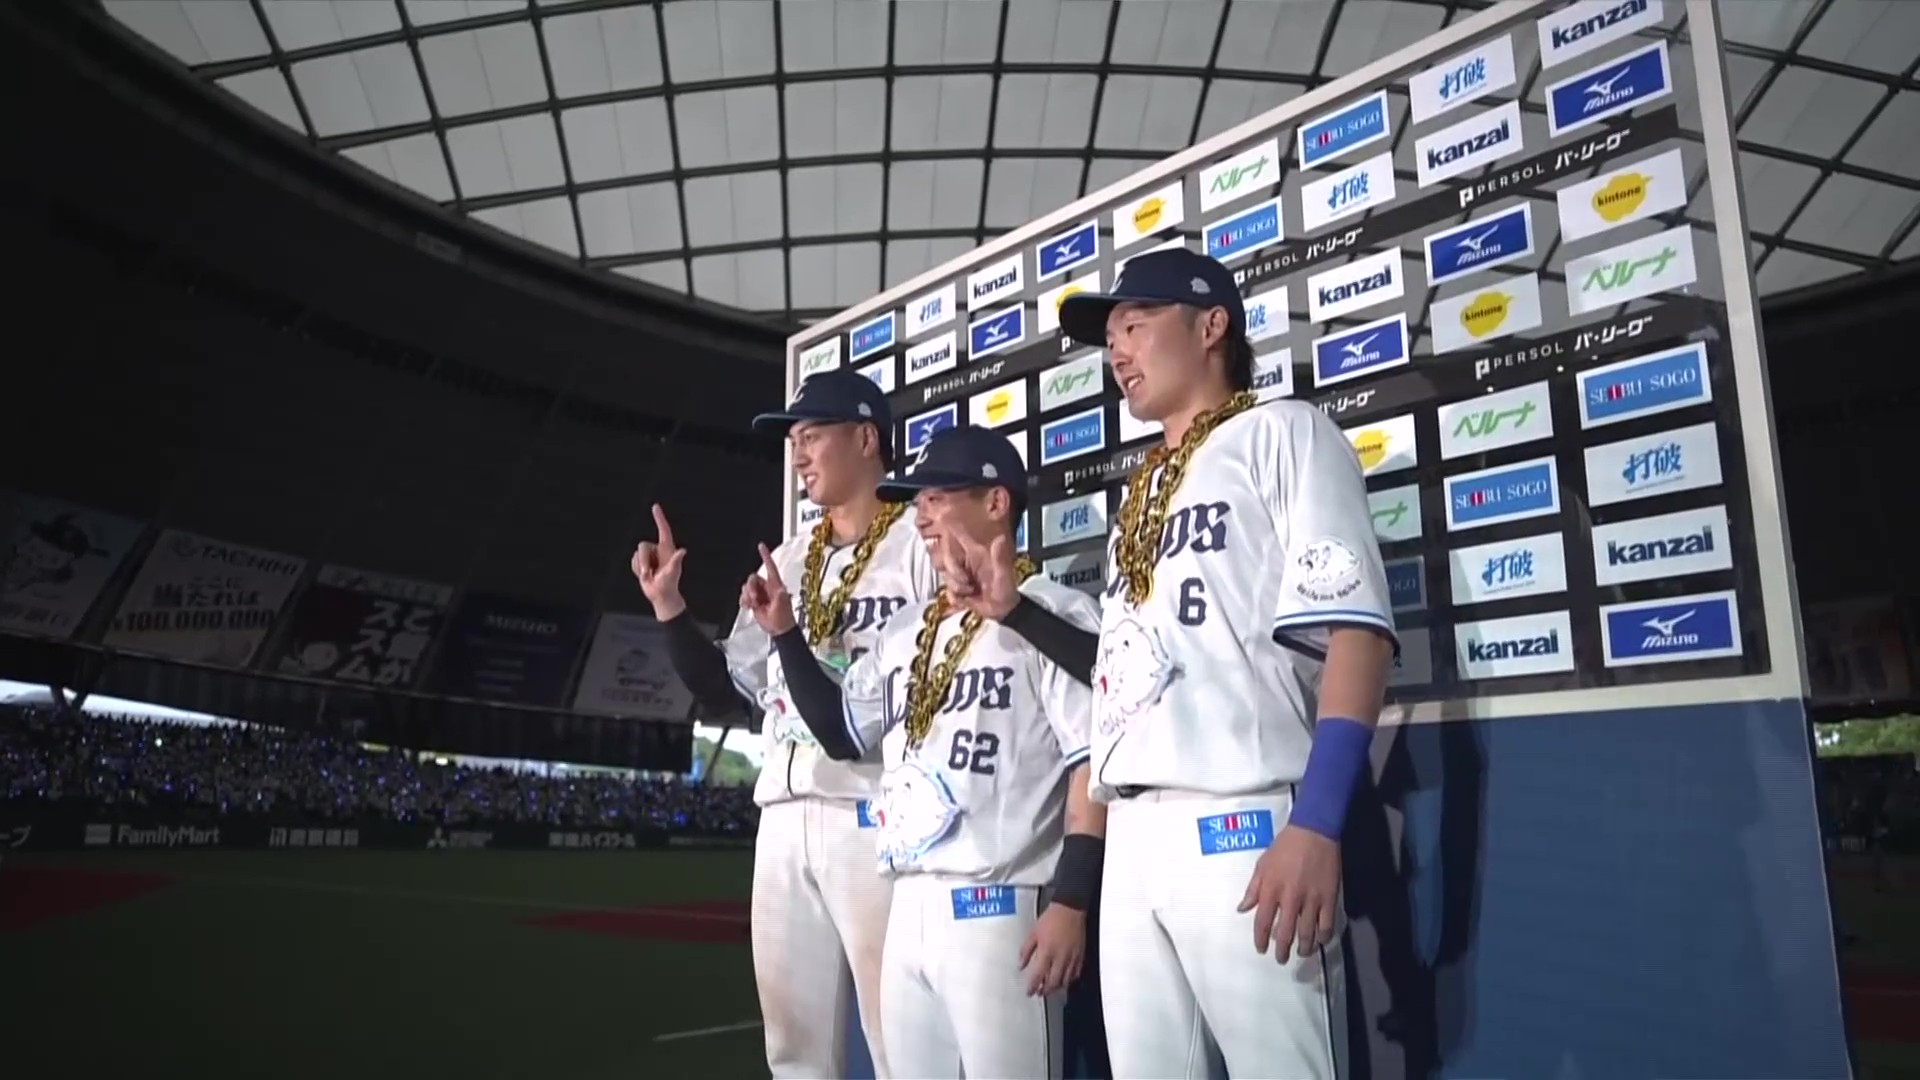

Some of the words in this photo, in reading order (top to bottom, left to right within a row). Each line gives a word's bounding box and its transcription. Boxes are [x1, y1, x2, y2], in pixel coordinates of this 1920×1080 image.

[1439, 57, 1486, 99] 打破
[1348, 111, 1380, 135] SOGO
[1209, 155, 1270, 194] ベルーナ
[1328, 170, 1369, 210] 打破
[1477, 164, 1545, 197] PERSOL
[1597, 184, 1642, 207] kintone
[1247, 216, 1276, 238] SOGO
[1246, 253, 1299, 279] PERSOL
[1582, 246, 1677, 292] ベルーナ
[1464, 304, 1503, 323] kintone
[1493, 341, 1564, 370] PERSOL
[1574, 315, 1654, 352] パ・リーグ
[1253, 364, 1283, 389] zai
[1589, 380, 1643, 406] SEIBU
[1650, 367, 1696, 391] SOGO
[1453, 401, 1536, 438] ベルーナ
[1357, 442, 1383, 455] ntone
[1622, 442, 1683, 485] 打破
[1075, 462, 1116, 480] PERSOL
[1455, 489, 1501, 511] SEIBU
[1507, 479, 1548, 501] SOGO
[1607, 525, 1714, 566] kanzai
[1481, 547, 1534, 586] 打破
[1179, 577, 1207, 626] 6
[948, 729, 1001, 775] 62
[117, 825, 220, 848] FamilyMart
[1209, 815, 1258, 834] SEIBU
[1215, 834, 1257, 850] SOGO
[961, 886, 1004, 902] SEIBU
[966, 901, 1001, 915] SOGO
